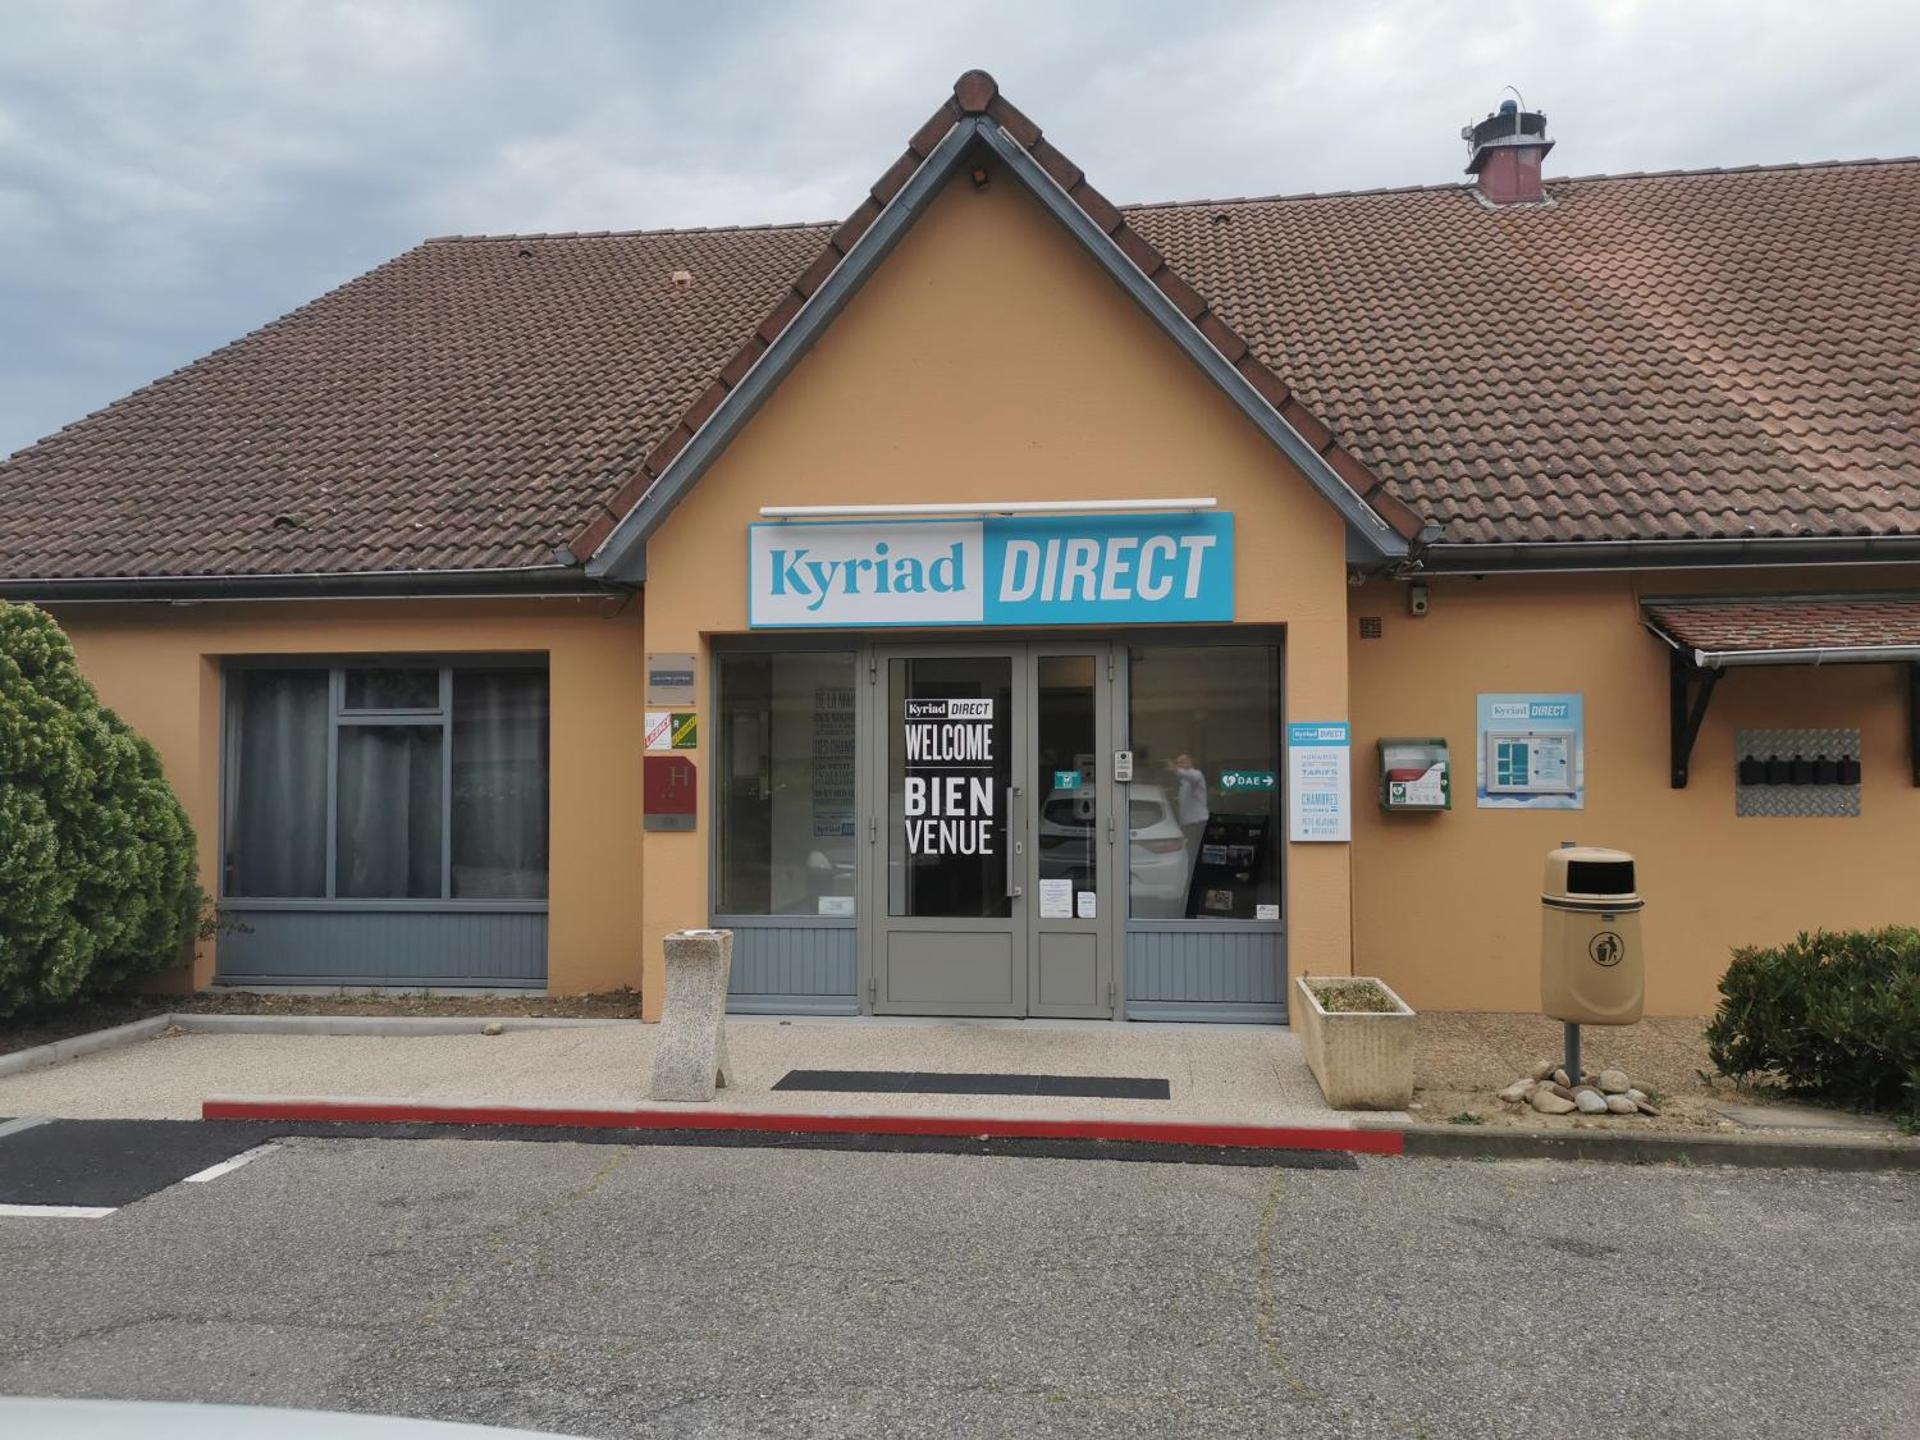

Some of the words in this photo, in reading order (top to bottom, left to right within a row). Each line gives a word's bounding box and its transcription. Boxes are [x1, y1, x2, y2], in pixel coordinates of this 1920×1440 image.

[770, 542, 965, 611] Kyriad
[1000, 535, 1217, 602] DIRECT
[909, 703, 946, 716] Kyriad
[951, 703, 990, 715] DIRECT
[1531, 705, 1566, 717] DIRECT
[905, 724, 993, 760] WELCOME
[1237, 777, 1261, 786] DAE
[1302, 769, 1338, 777] TARIFS
[904, 777, 993, 816] BIEN
[905, 820, 993, 854] VENUE
